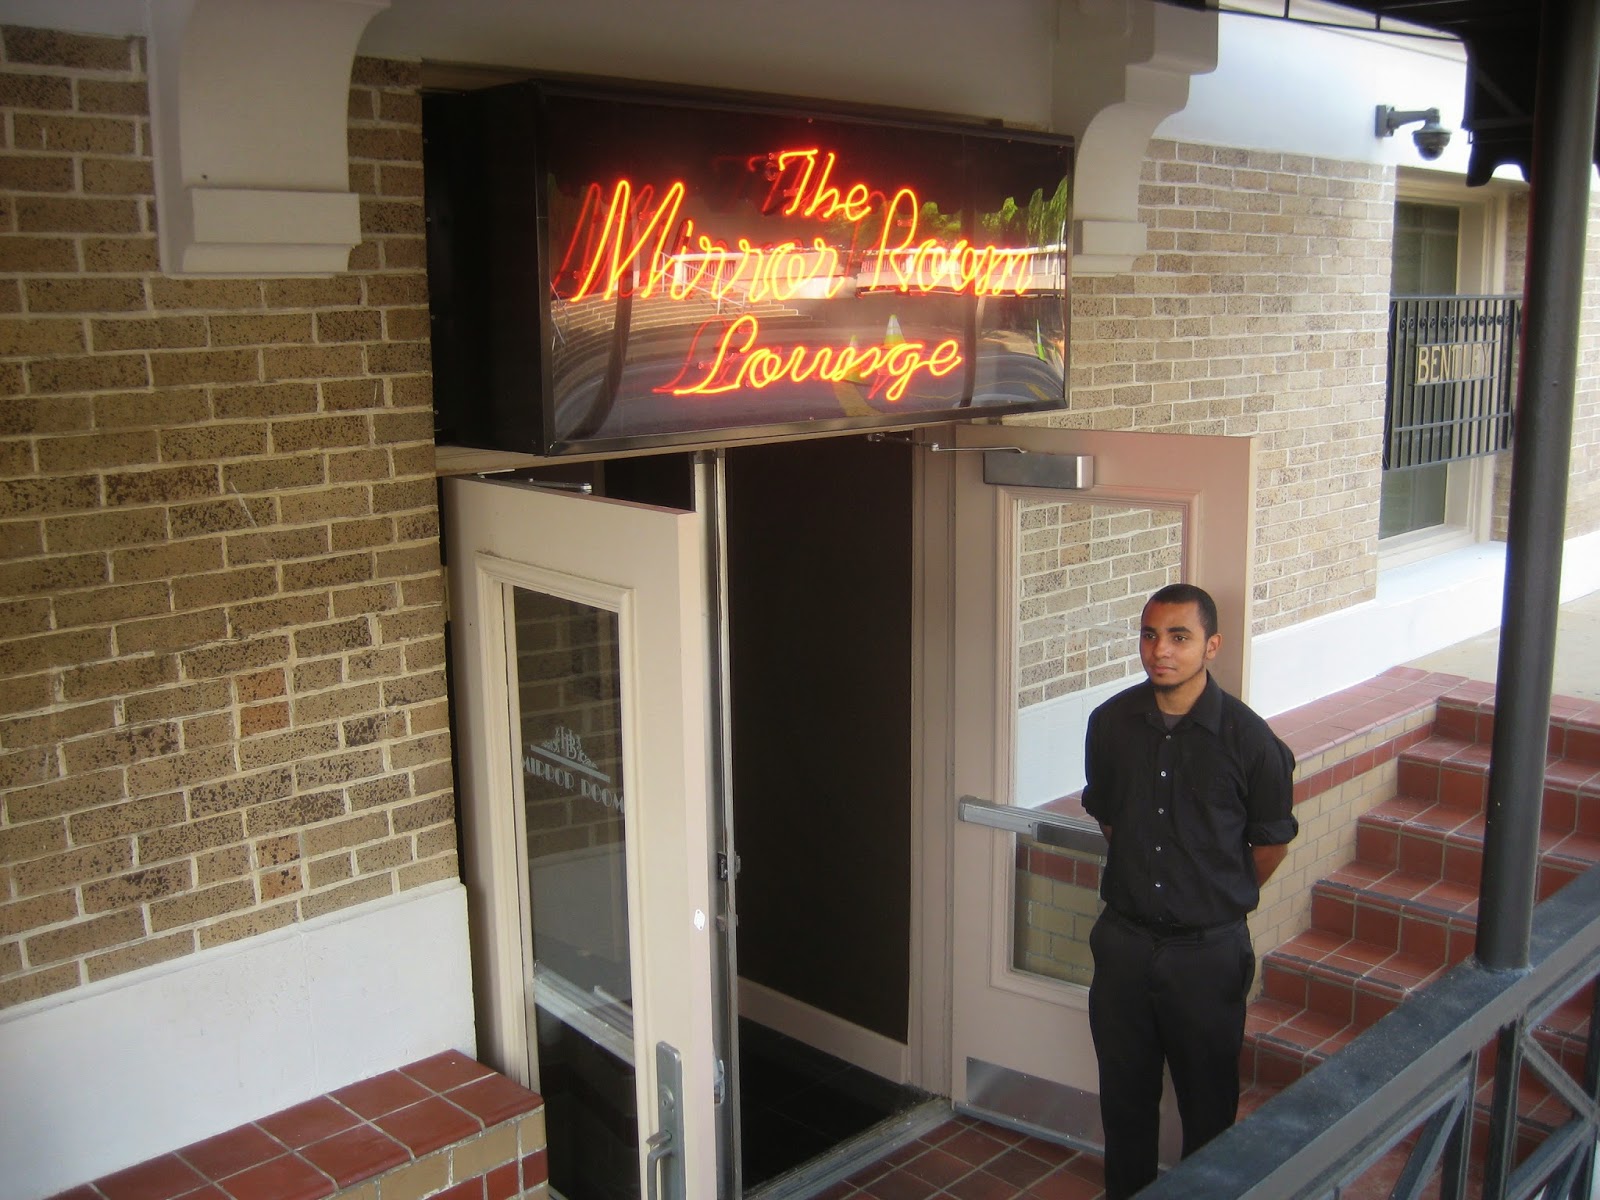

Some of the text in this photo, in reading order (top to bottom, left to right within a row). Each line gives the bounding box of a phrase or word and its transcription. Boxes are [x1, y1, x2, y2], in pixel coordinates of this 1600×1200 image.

[779, 148, 872, 223] The
[569, 178, 1034, 304] Mirror Room
[672, 314, 964, 402] Lounge
[1416, 342, 1492, 386] BENTLEY
[580, 778, 624, 814] ROOM
